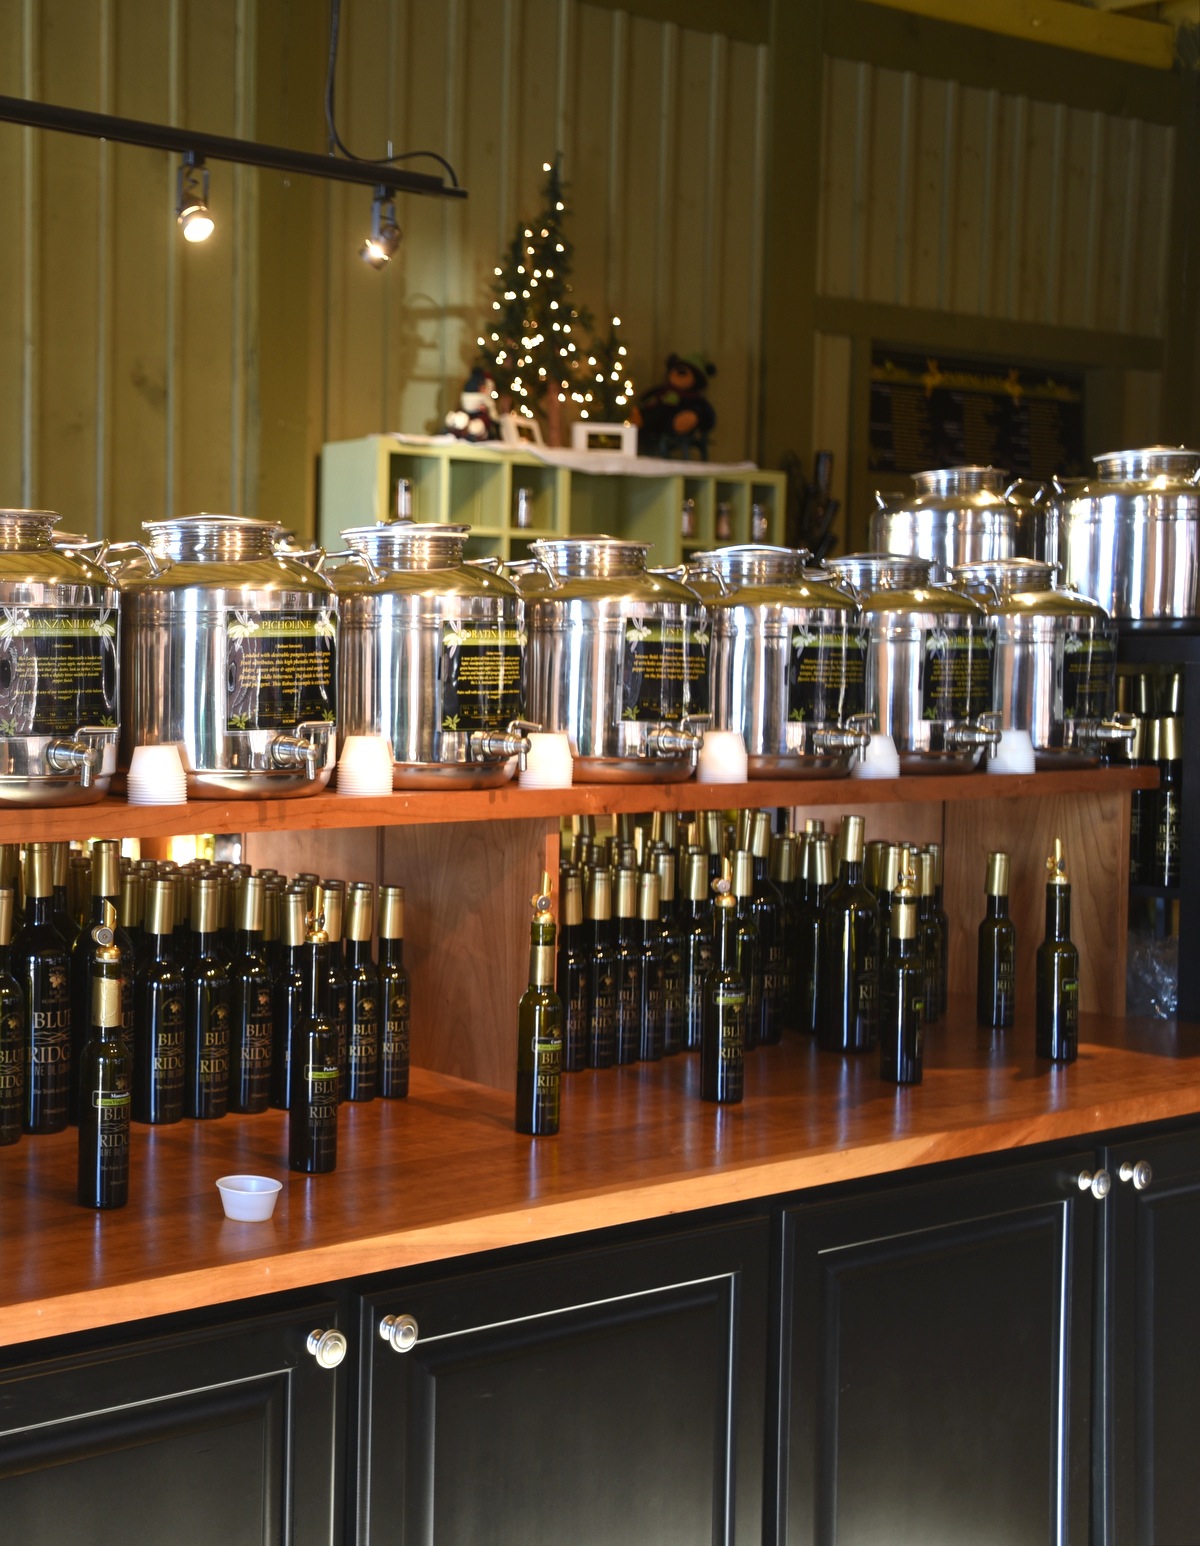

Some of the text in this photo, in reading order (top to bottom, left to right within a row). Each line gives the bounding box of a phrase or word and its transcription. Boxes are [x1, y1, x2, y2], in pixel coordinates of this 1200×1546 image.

[26, 619, 94, 629] MANZANILLO
[262, 621, 312, 630] PICHOLINE
[33, 1009, 72, 1029] BLUE
[246, 1023, 272, 1037] BLU
[353, 1023, 378, 1036] BLU
[158, 1032, 185, 1046] BLU
[205, 1031, 229, 1046] BLU
[27, 1045, 72, 1064] RIDG
[240, 1047, 272, 1061] RIDG
[349, 1045, 378, 1057] RIDG
[154, 1057, 185, 1071] RIDG
[542, 1052, 561, 1065] BLU
[199, 1059, 229, 1074] RIDG
[314, 1081, 336, 1094] BLU
[537, 1075, 561, 1087] RID
[104, 1106, 129, 1121] BLU
[309, 1105, 337, 1119] RIDG
[100, 1133, 130, 1148] RIDG
